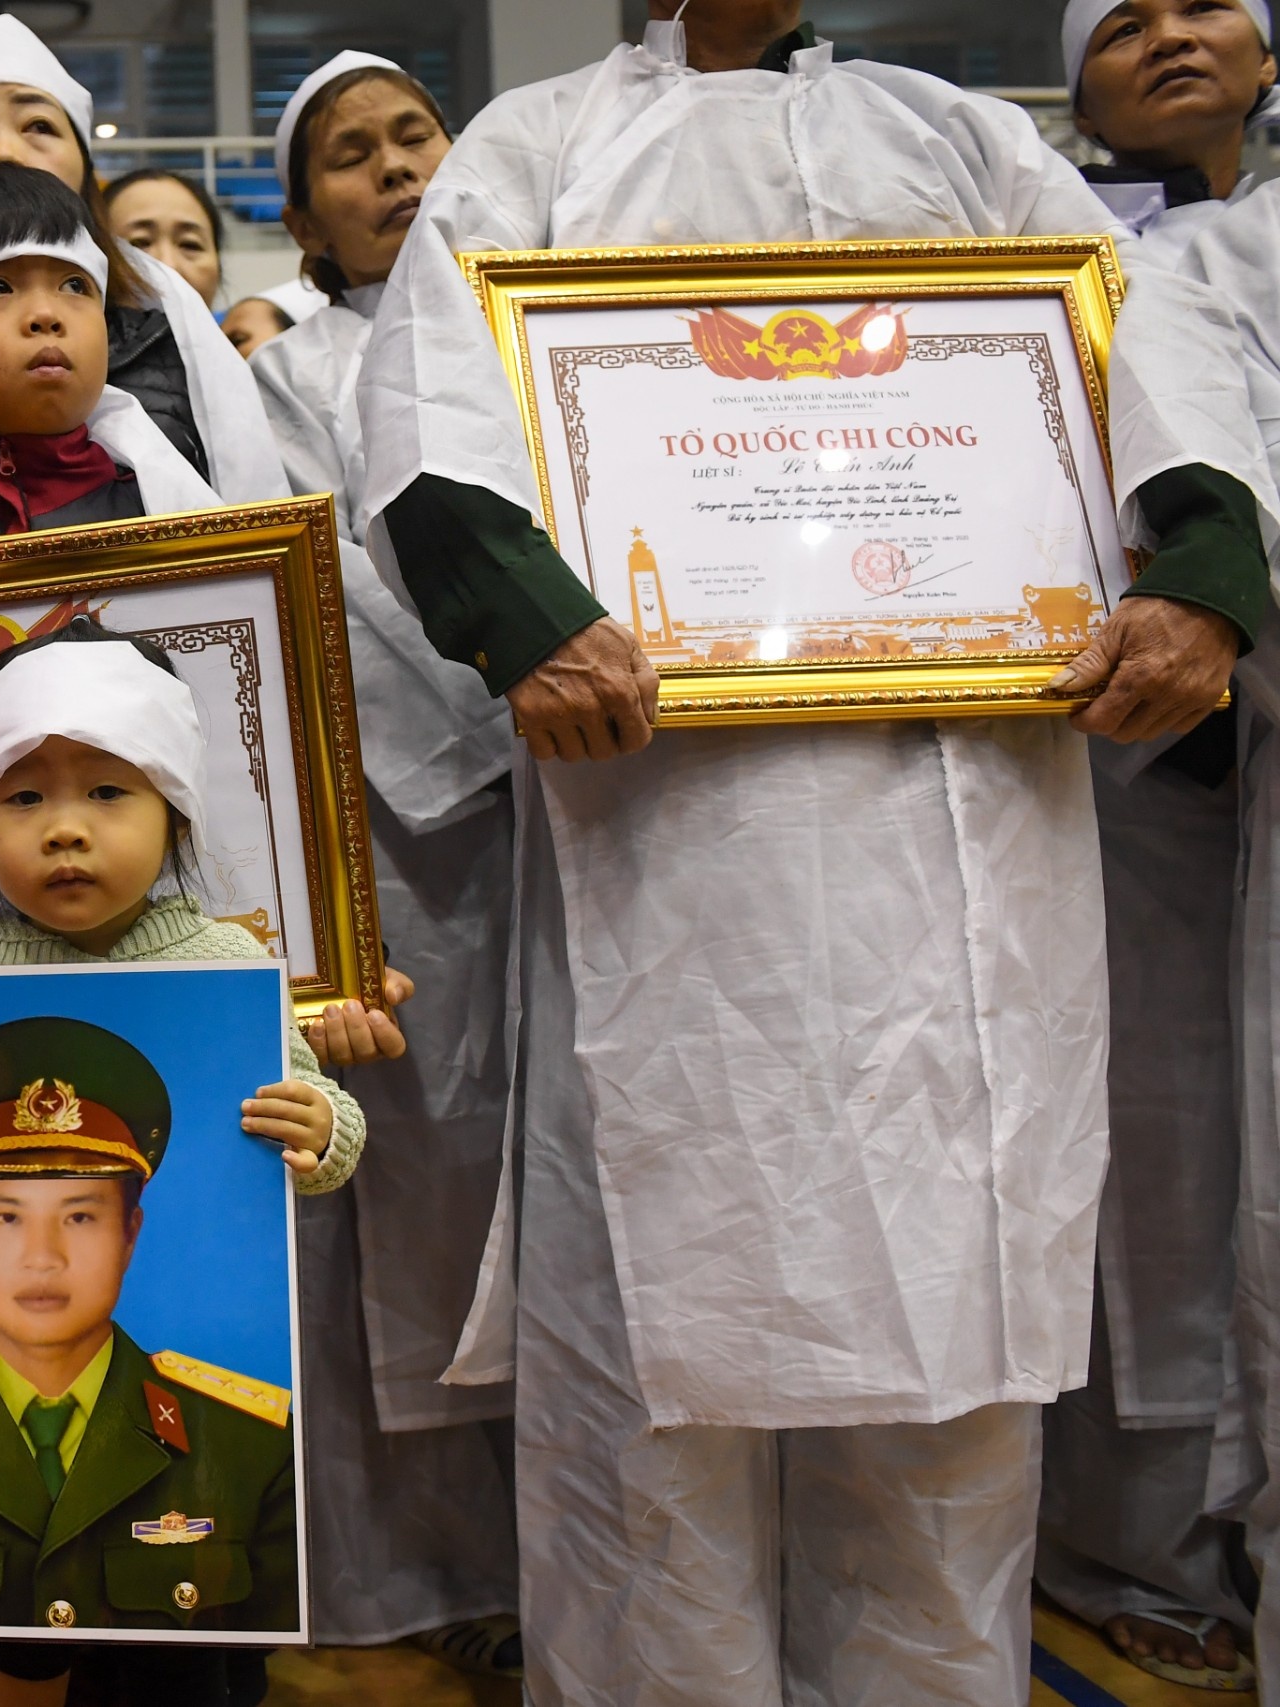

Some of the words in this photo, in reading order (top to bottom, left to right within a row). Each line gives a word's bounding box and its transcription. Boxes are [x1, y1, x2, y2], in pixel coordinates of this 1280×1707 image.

[659, 427, 705, 456] TỔ
[712, 424, 811, 459] QUỐC
[816, 427, 879, 450] GHI
[885, 422, 978, 449] CÔNG
[692, 467, 721, 480] LIỆT
[723, 465, 735, 477] SĨ
[779, 457, 806, 475] Lê
[869, 453, 916, 472] Anh
